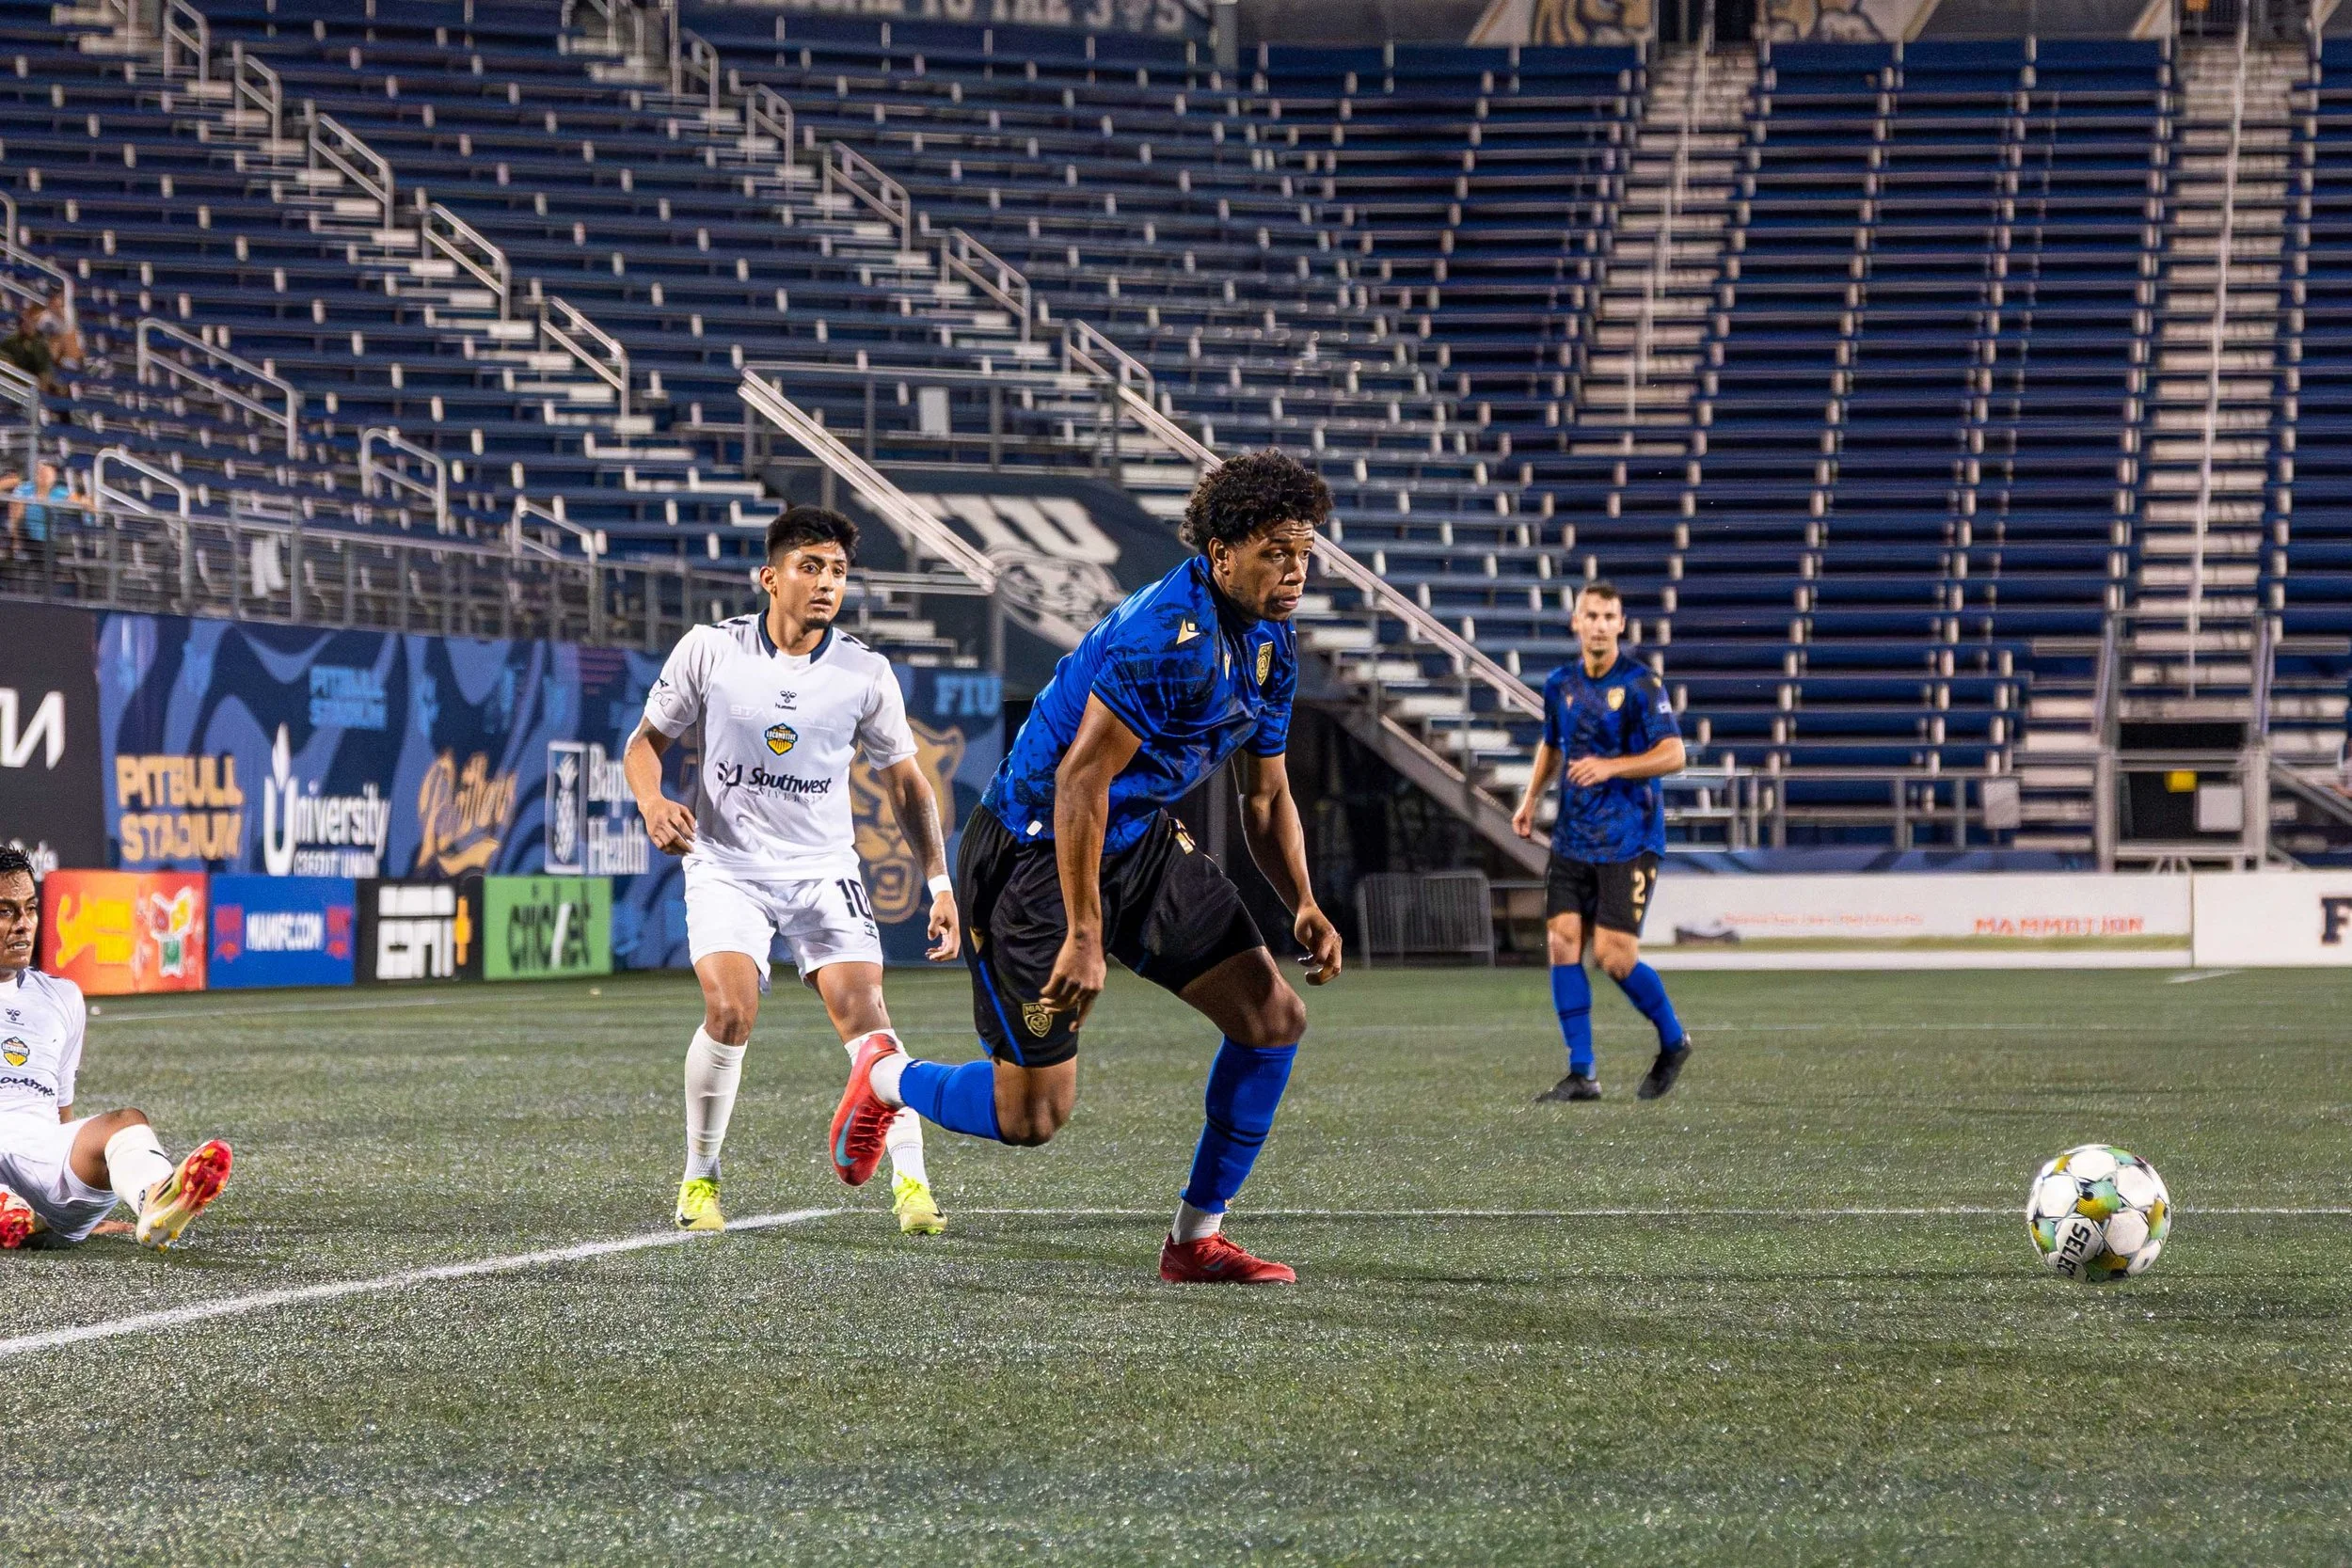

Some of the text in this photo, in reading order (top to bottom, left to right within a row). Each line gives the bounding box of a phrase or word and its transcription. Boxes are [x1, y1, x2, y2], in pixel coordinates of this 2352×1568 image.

[932, 674, 1003, 716] FIU
[116, 754, 245, 808] PITBULL
[748, 767, 832, 794] Southwest
[119, 811, 242, 863] STADIUM
[263, 775, 392, 877] University
[587, 816, 648, 875] Health
[835, 878, 874, 921] 10
[1631, 868, 1646, 905] 2
[1974, 915, 2146, 935] MAMMOTION
[2057, 1222, 2092, 1277] SELEC
